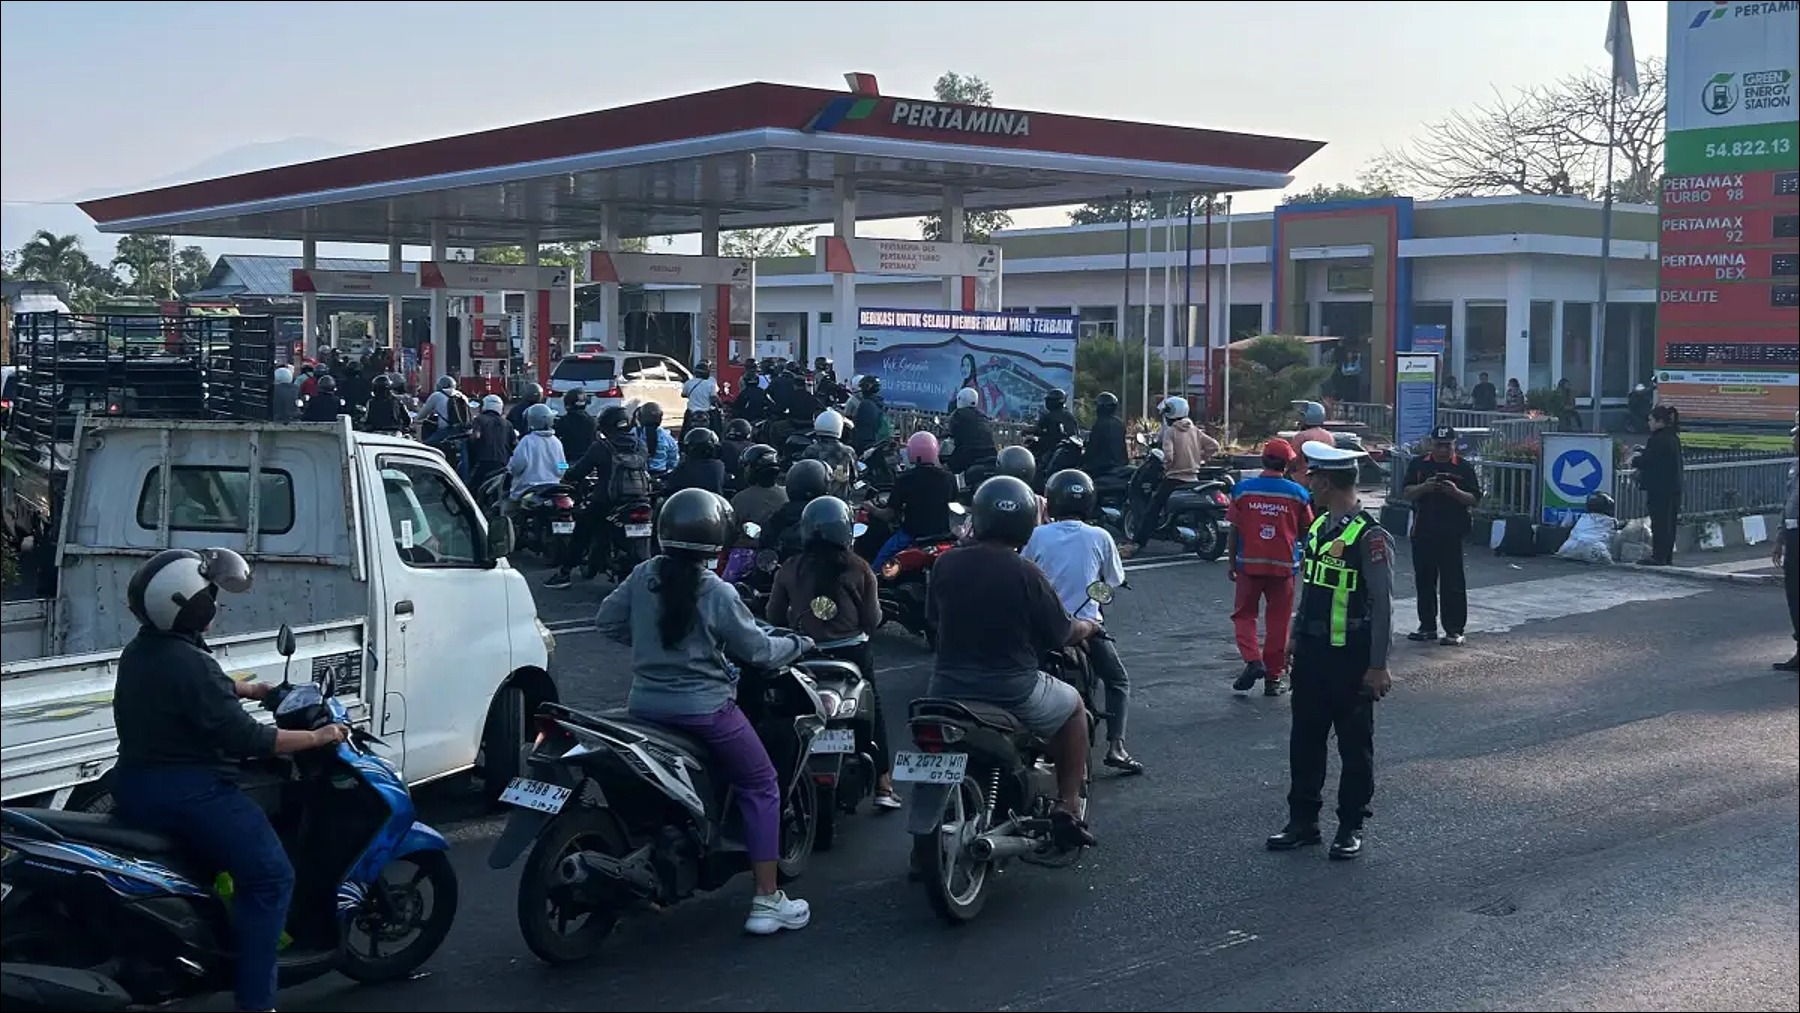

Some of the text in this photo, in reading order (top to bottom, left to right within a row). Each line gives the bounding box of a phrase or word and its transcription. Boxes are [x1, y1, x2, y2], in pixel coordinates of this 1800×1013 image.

[1745, 72, 1783, 85] GREEN
[1745, 84, 1790, 98] ENERGY
[1745, 96, 1790, 110] STATION
[891, 101, 1030, 136] PERTAMINA
[1705, 138, 1791, 158] 54.822.13
[1663, 174, 1744, 190] PERTAMAX
[1664, 189, 1744, 203] TURBO 98
[1662, 216, 1744, 231] PERTAMAX
[1726, 231, 1744, 243] 92
[1661, 253, 1746, 267] PERTAMINA
[1715, 267, 1746, 280] DEX
[1661, 290, 1719, 303] DEXLITE
[860, 311, 1074, 334] DEDIKASI UNTUK SELALU MEMBERIKAN YANG TERBAIK
[1248, 502, 1289, 513] MARSHAL
[896, 754, 911, 766] DK
